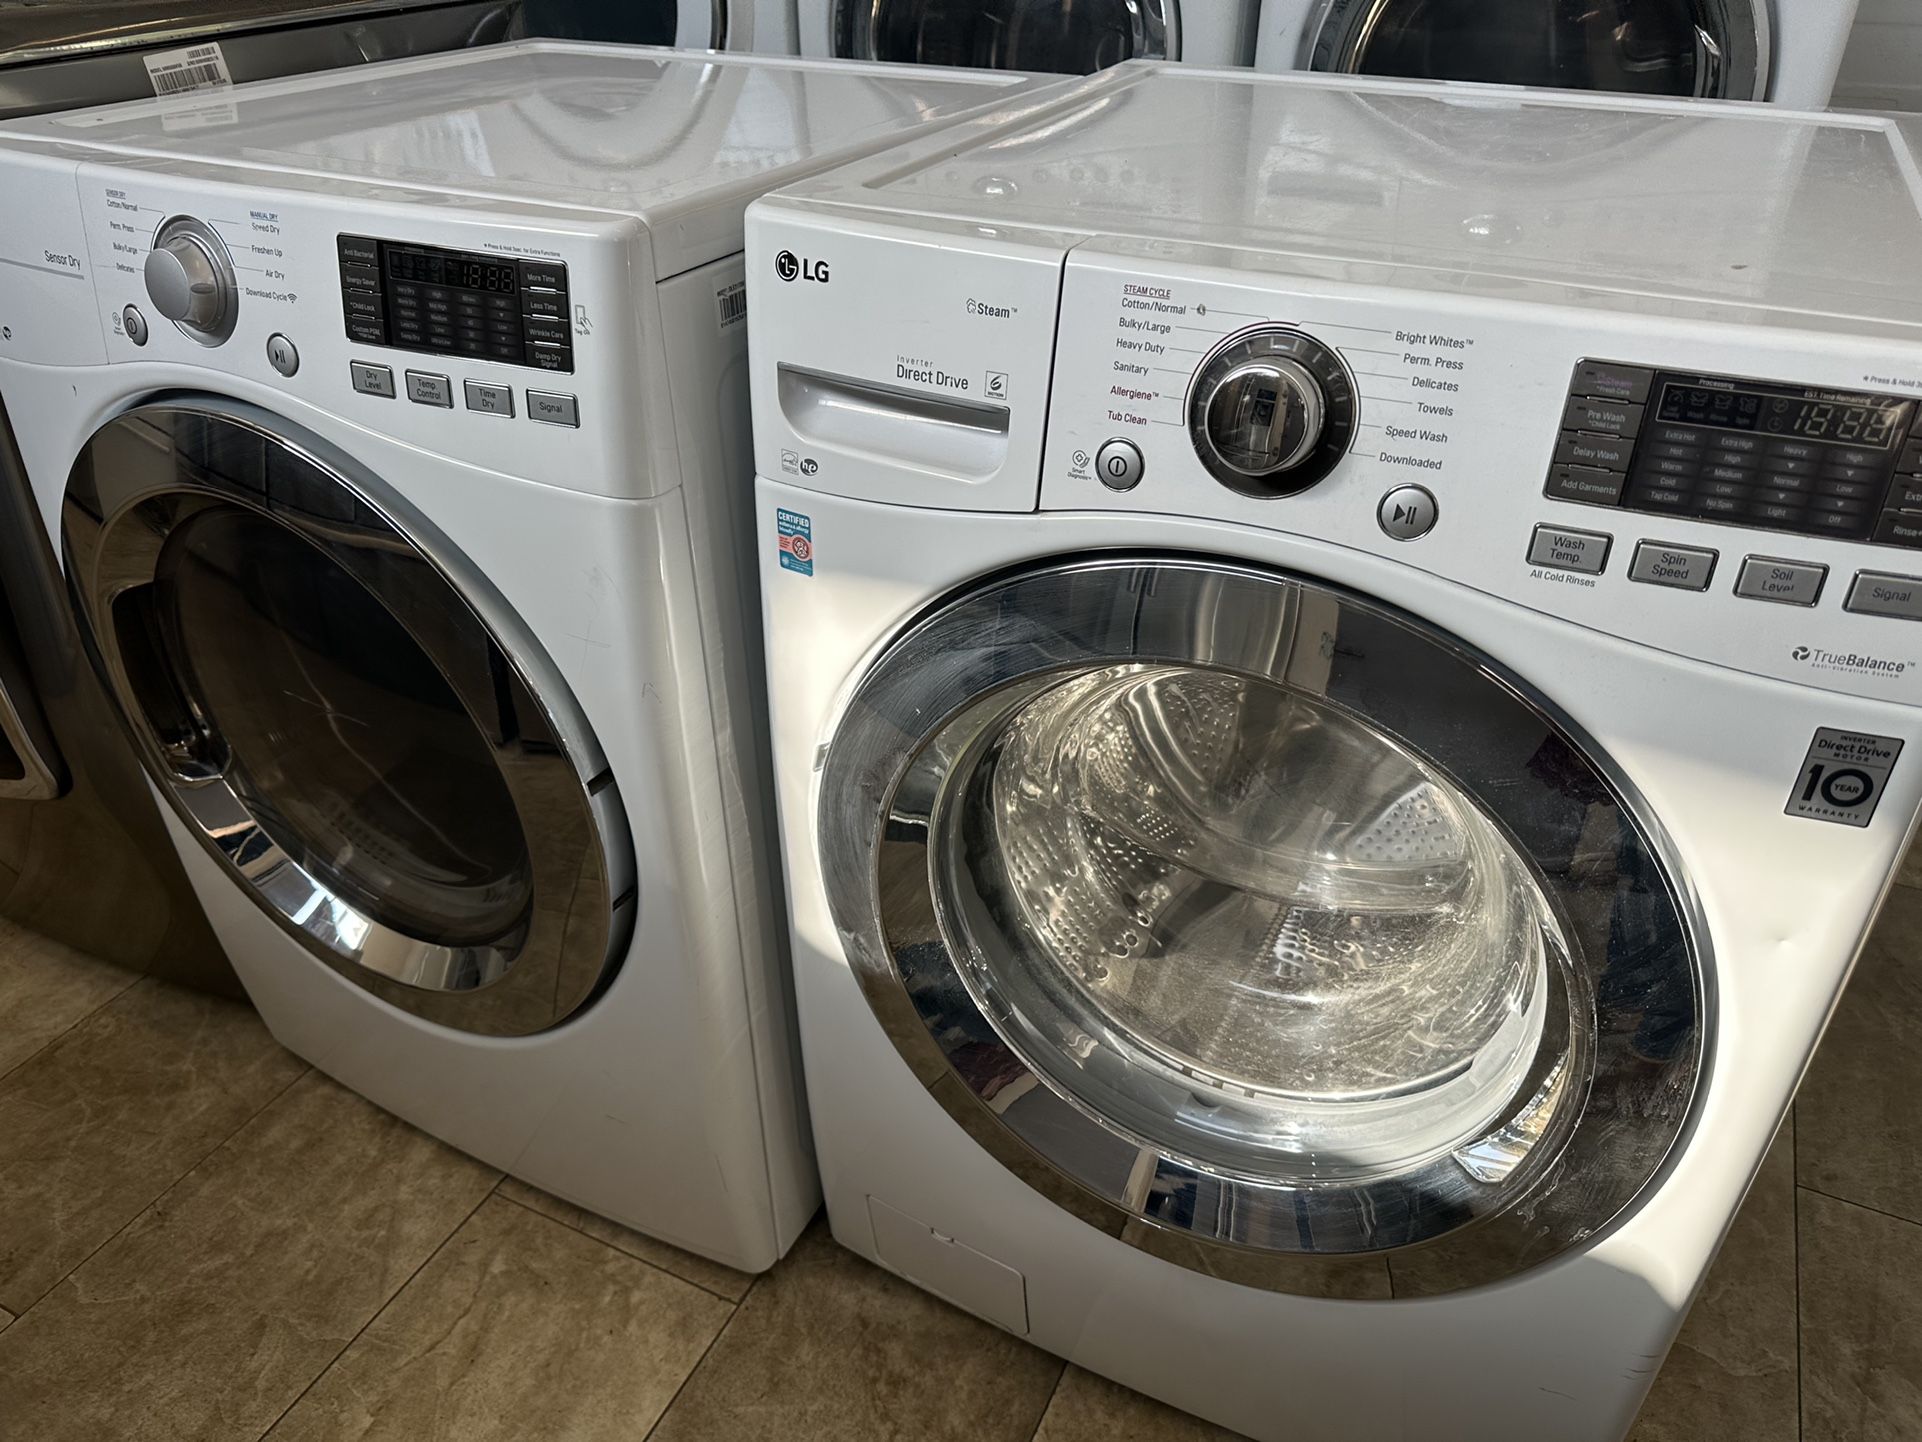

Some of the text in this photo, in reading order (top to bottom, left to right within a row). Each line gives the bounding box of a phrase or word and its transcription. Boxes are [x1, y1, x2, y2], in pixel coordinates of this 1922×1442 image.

[250, 211, 268, 219] MANUAL
[252, 223, 280, 235] Speed Dry
[251, 245, 282, 257] Freshen Up
[45, 250, 80, 270] Sensor Dry
[274, 271, 285, 280] Dry
[803, 259, 829, 282] LG
[527, 273, 555, 283] More Time
[246, 287, 287, 302] Download Cycle
[1124, 284, 1171, 298] STEAM CYCLE
[544, 303, 557, 311] Time
[1122, 298, 1186, 315] Cotton/Normal
[1119, 317, 1171, 334] Bulky/Large
[529, 328, 550, 336] Wrinkle
[1395, 331, 1426, 345] Bright
[1116, 338, 1165, 354] Heavy Duty
[535, 352, 550, 361] Damp
[897, 354, 934, 368] Inverter
[1403, 353, 1464, 370] Perm. Press
[541, 360, 558, 368] Signal
[1114, 361, 1149, 375] Sanitary
[366, 371, 378, 381] Dry
[897, 364, 933, 384] Direct
[936, 371, 968, 390] Drive
[365, 380, 381, 390] Level
[1412, 376, 1459, 392] Delicates
[1699, 379, 1735, 390] Processing
[417, 389, 441, 399] Control
[480, 388, 496, 398] Time
[482, 399, 495, 409] Dry
[540, 402, 562, 414] Signal
[1417, 402, 1454, 416] Towels
[1107, 410, 1147, 426] Tub Clean
[1588, 410, 1625, 422] Pre Wash
[1386, 425, 1448, 443] Speed Wash
[1573, 447, 1619, 460] Delay Wash
[1784, 445, 1807, 456] Heavy
[1379, 452, 1442, 470] Downloaded
[1724, 455, 1741, 464] High
[1846, 451, 1863, 463] High
[1661, 462, 1682, 471] Warm
[1714, 468, 1742, 479] Medium
[1561, 480, 1617, 495] Add Garments
[1660, 477, 1676, 486] Cold
[1773, 477, 1799, 487] Normal
[1716, 485, 1732, 493] Low
[1836, 484, 1853, 494] Low
[1768, 507, 1786, 517] Light
[779, 511, 809, 527] CERTIFIED
[1828, 516, 1841, 524] Off
[1554, 536, 1585, 550] Wash
[1550, 548, 1582, 563] Temp.
[1661, 552, 1687, 566] Spin
[1651, 565, 1689, 579] Speed
[1771, 568, 1794, 580] Soil
[1530, 569, 1596, 588] All Cold Rinses
[1872, 587, 1912, 602] Signal
[1841, 735, 1876, 745] INVERTER
[1818, 739, 1891, 759] Direct Drive
[1833, 752, 1869, 762] MOTOR
[1802, 764, 1874, 807] 10
[1834, 784, 1859, 794] YEAR
[1799, 805, 1860, 820] WARRANTY
